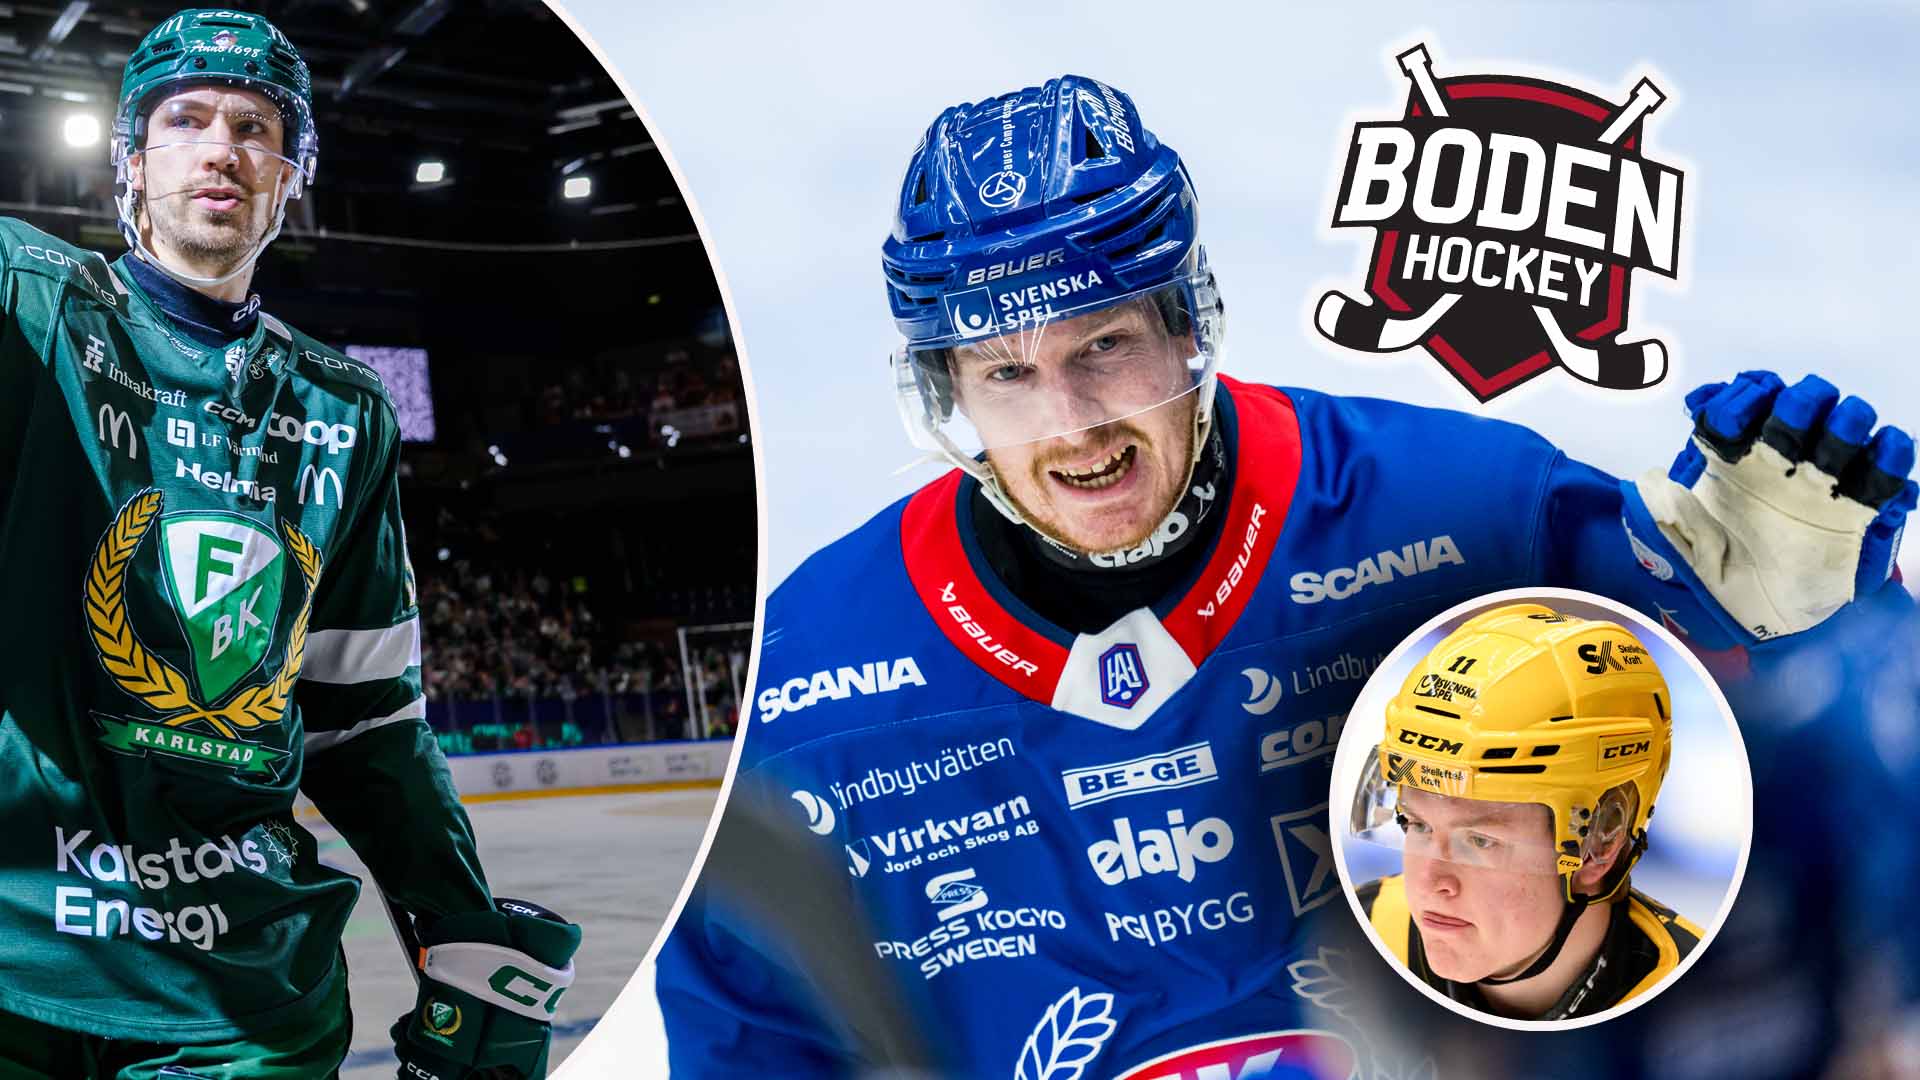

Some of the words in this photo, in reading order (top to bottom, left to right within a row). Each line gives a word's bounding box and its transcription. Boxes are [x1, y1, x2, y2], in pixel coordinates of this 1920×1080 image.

[967, 248, 1065, 285] BAUER
[999, 270, 1103, 311] SVENSKA
[1004, 304, 1060, 330] SPEL
[204, 401, 256, 427] CCM
[267, 412, 357, 454] coop
[1215, 503, 1268, 605] BAUER
[1289, 535, 1466, 604] SCANIA
[948, 605, 1039, 677] BAUER
[1448, 656, 1477, 674] 11
[757, 656, 927, 723] SCANIA
[135, 726, 255, 763] KARLSTAD
[1399, 728, 1464, 755] CCM
[1604, 740, 1650, 759] CCM
[1078, 754, 1201, 791] BE-GE
[871, 795, 1031, 857] Virkvarn
[884, 856, 922, 874] Jord
[927, 844, 960, 862] och
[965, 829, 1010, 850] Skog
[1014, 819, 1040, 837] AB
[1087, 809, 1234, 886] elajo
[501, 902, 539, 917] CCM
[1155, 892, 1255, 943] BYGG
[874, 917, 971, 960] PRESS
[976, 907, 1066, 931] KOGYO
[920, 934, 1037, 981] SWEDEN
